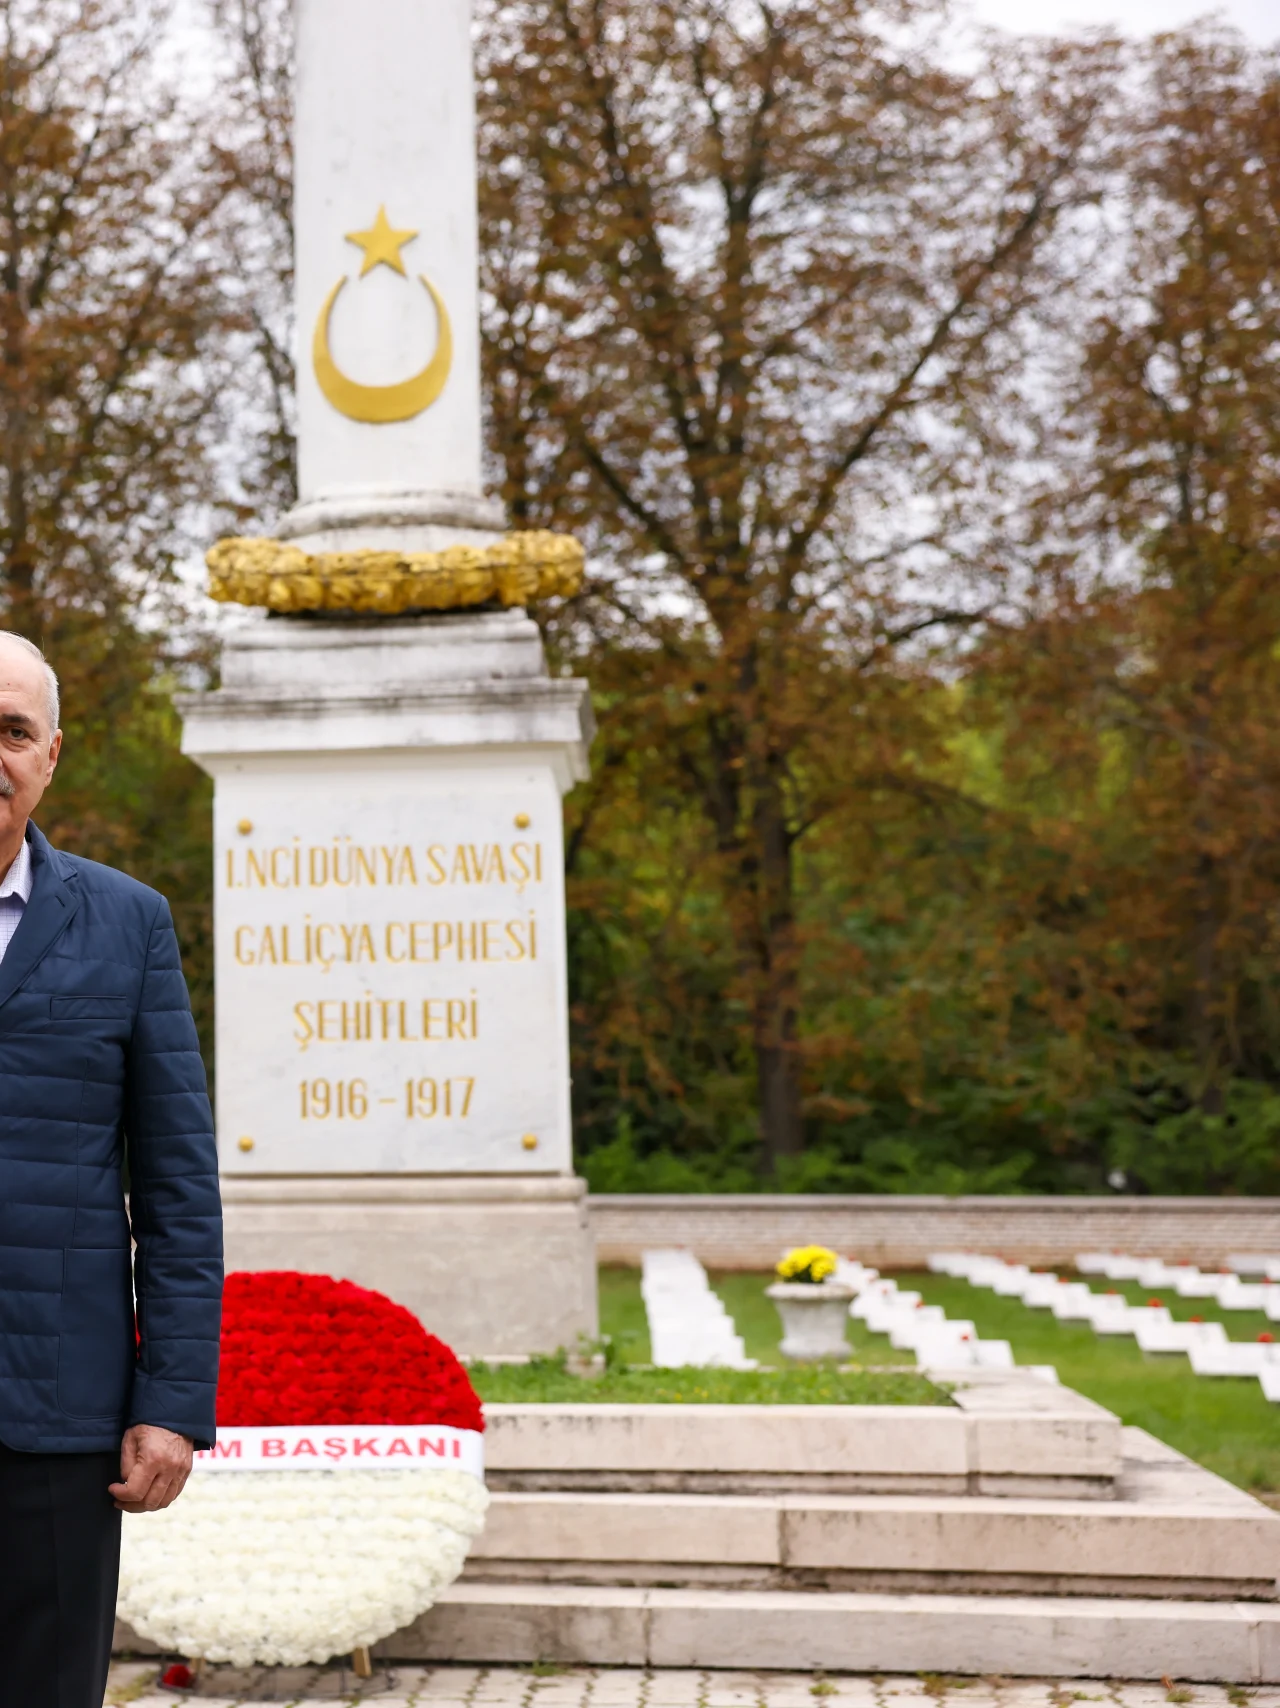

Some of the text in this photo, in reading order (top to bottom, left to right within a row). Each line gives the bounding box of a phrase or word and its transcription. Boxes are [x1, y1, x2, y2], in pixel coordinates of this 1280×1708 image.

[308, 835, 418, 888] DÜNYA
[426, 841, 543, 894] SAVAŞI
[234, 909, 538, 974] GALİÇYA CEPHESİ
[293, 988, 478, 1053] ŞEHİTLERİ
[298, 1077, 369, 1120] 1916
[405, 1076, 476, 1119] 1917
[261, 1438, 461, 1461] BAŞKANI
